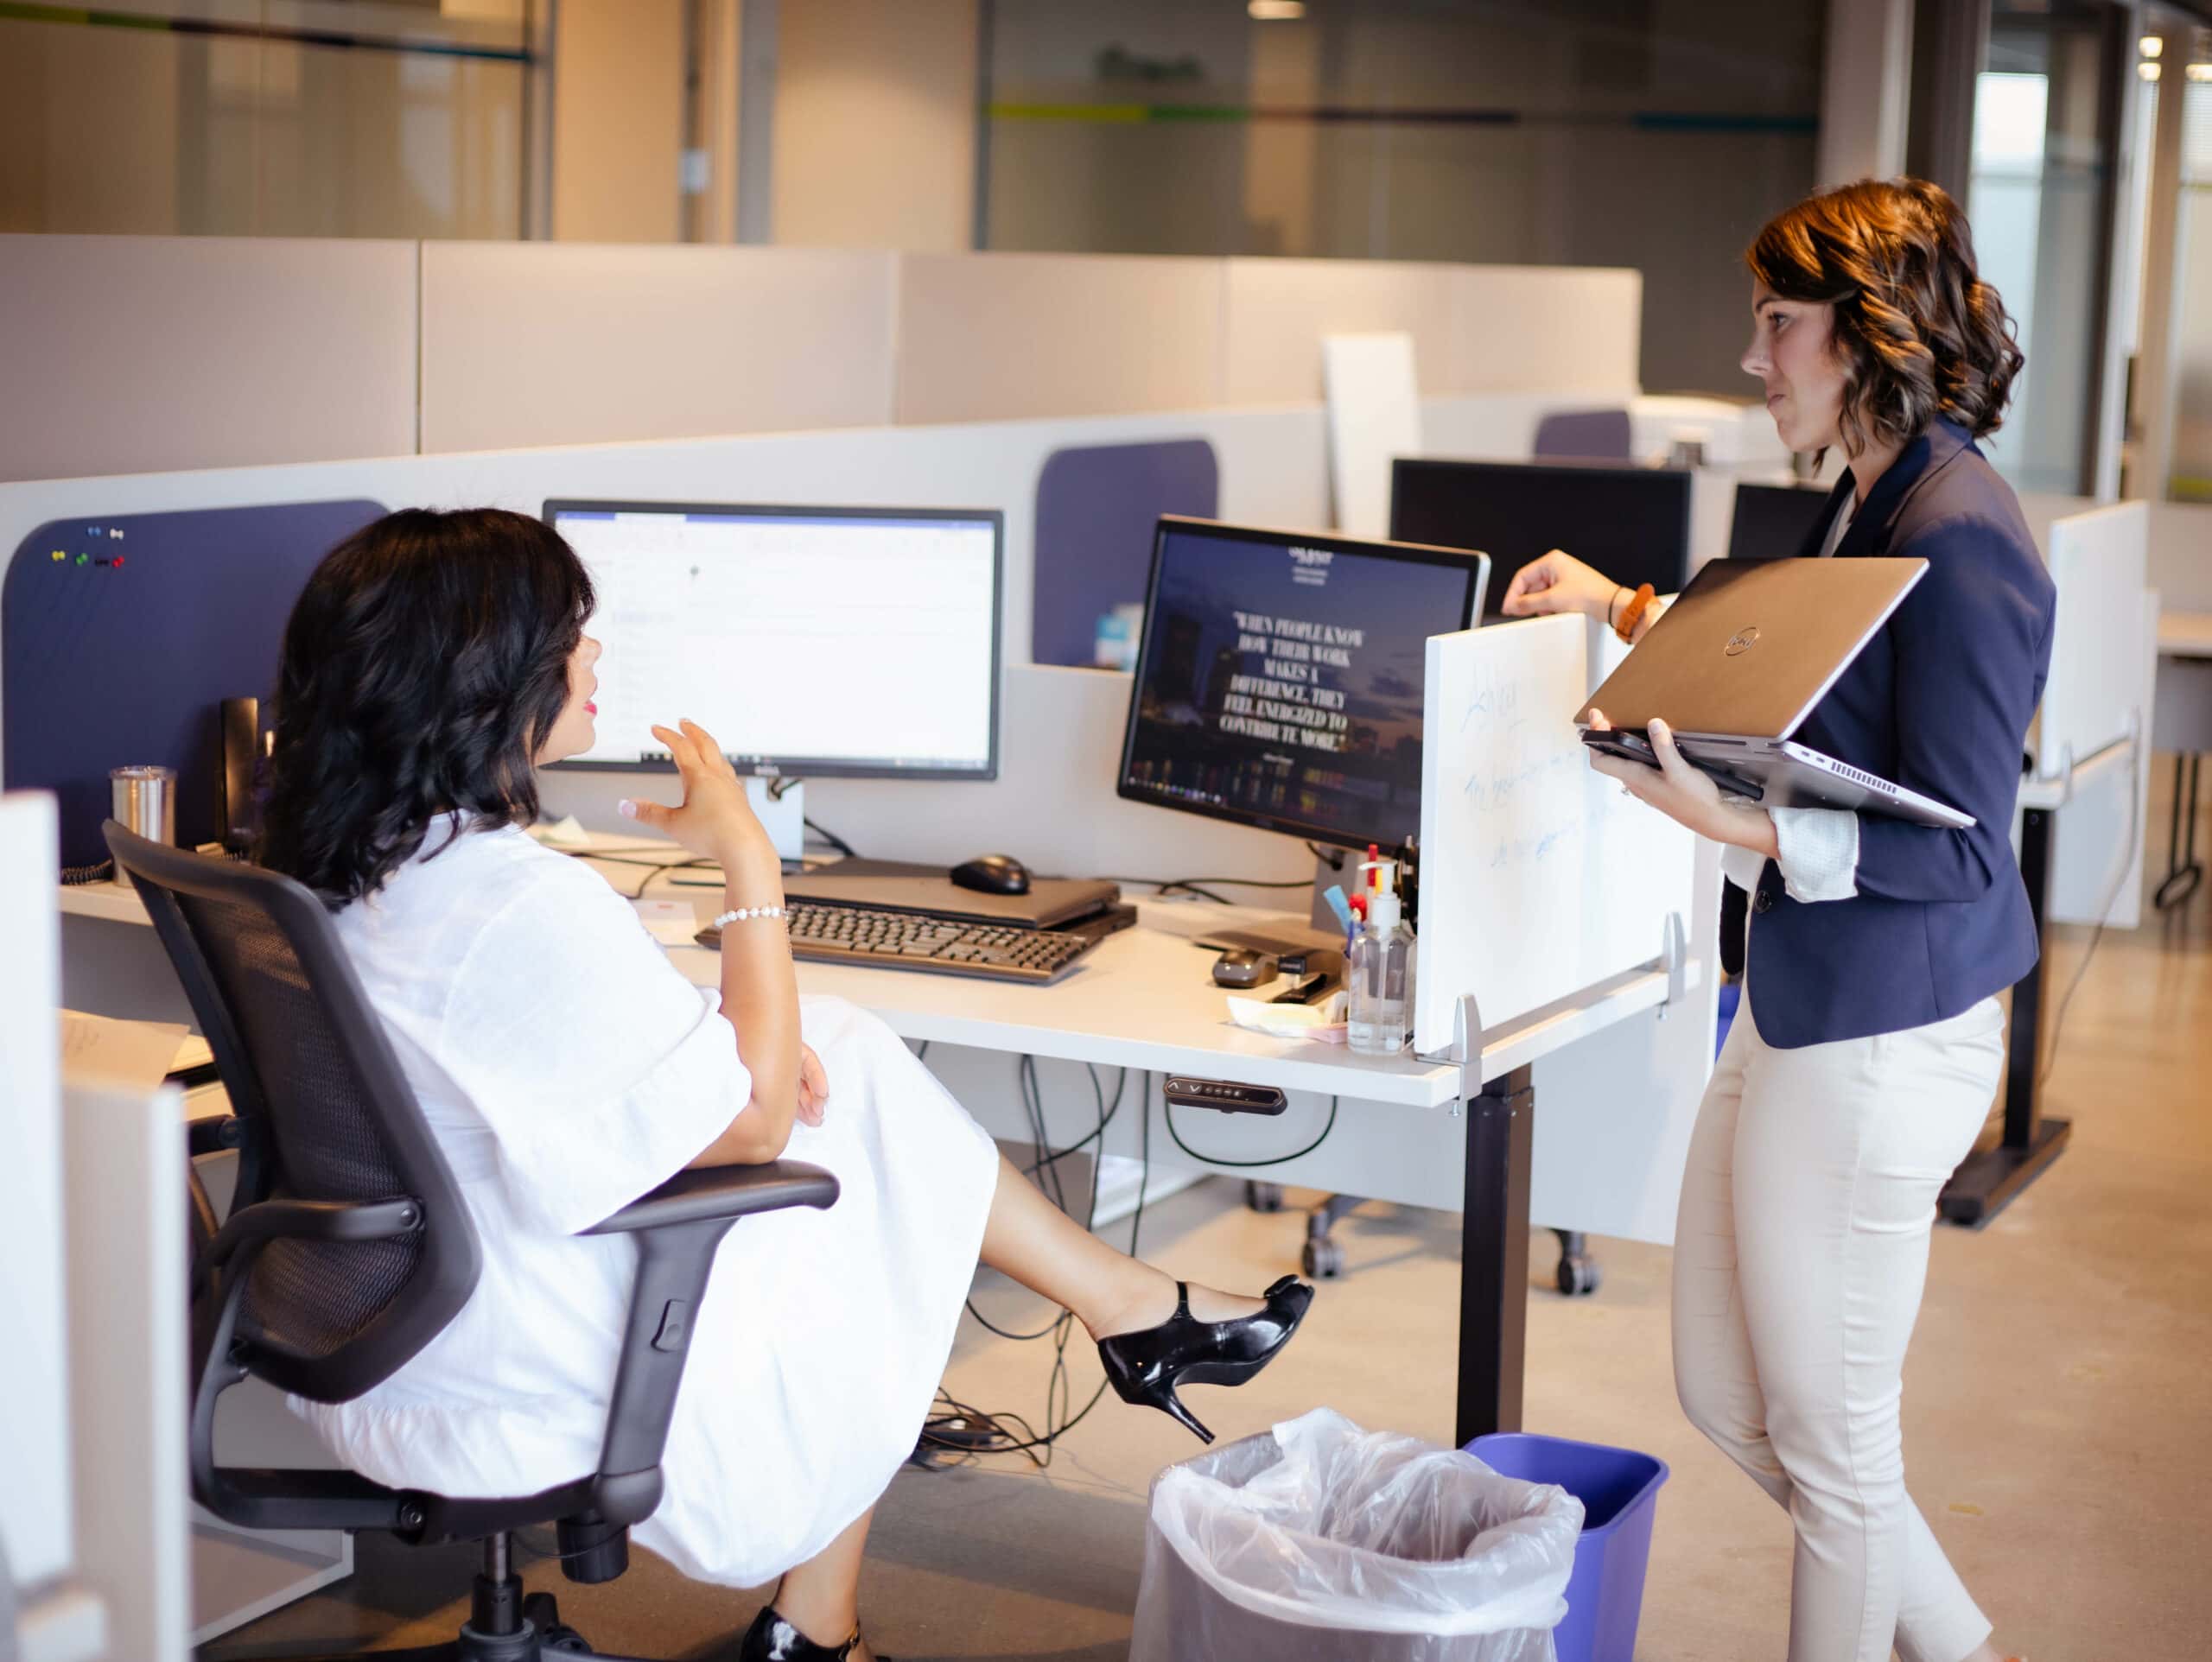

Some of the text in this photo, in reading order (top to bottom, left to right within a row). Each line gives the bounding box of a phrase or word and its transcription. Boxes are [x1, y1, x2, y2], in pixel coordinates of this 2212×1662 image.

[1274, 618, 1323, 643] PEOPLE
[1324, 625, 1364, 648] KNOW
[1238, 634, 1351, 668] HOW THEIR WORK
[1264, 658, 1307, 680] MAKES
[1223, 694, 1348, 732] FEEL ENERGIZED TO
[1313, 688, 1345, 709] THEY
[1219, 715, 1300, 744] CONTRIBUTE
